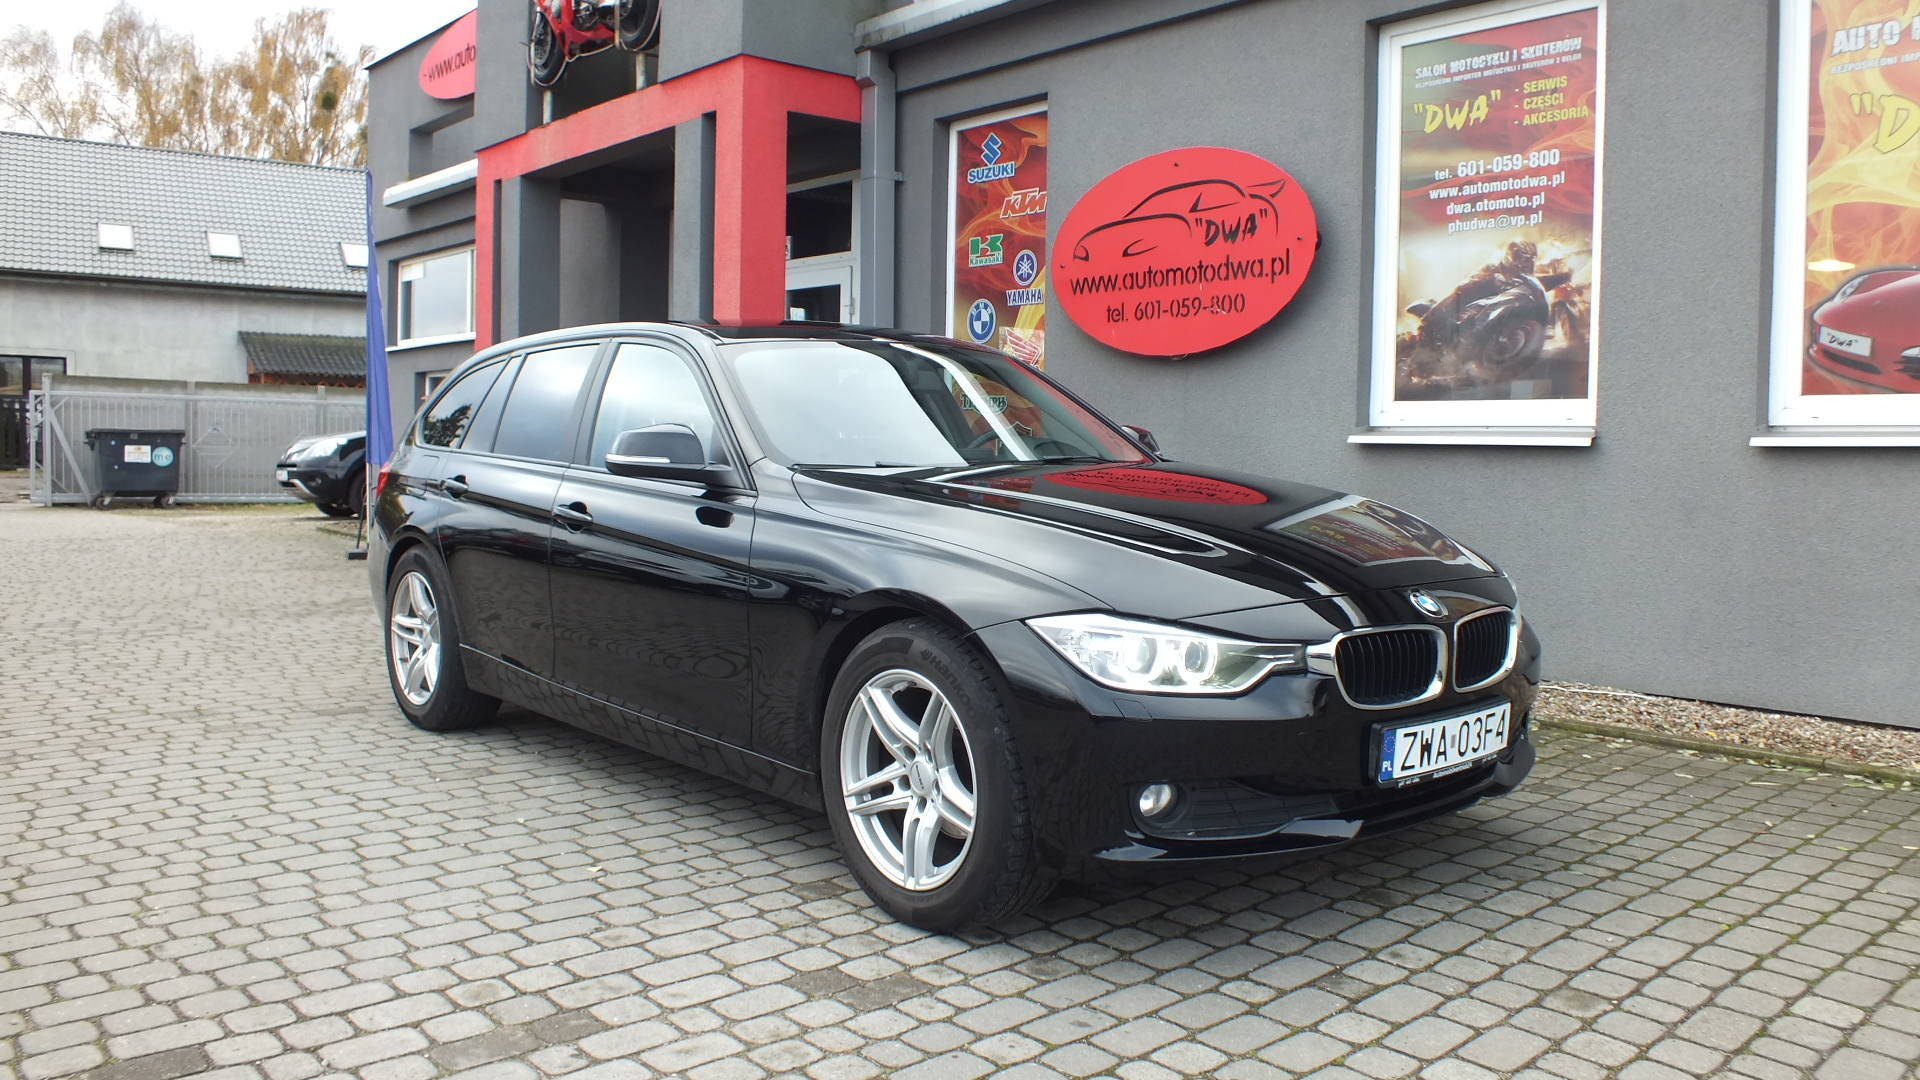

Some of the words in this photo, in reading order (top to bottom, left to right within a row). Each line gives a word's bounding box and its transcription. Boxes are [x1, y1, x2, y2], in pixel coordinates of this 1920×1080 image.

[1832, 20, 1901, 56] AUTO
[1416, 64, 1446, 79] SALON
[1450, 50, 1509, 73] MOTOCYKLI
[1521, 34, 1582, 59] SKUTERÓW
[1830, 56, 1898, 74] BEZPOŚREDNI
[1523, 76, 1568, 94] SERWIS
[1413, 90, 1502, 134] "DWA"
[1523, 92, 1564, 111] CZĘŚCI
[1523, 105, 1588, 126] AKCESORIA
[968, 162, 1015, 184] SUZUKI
[1434, 168, 1452, 181] tel.
[1457, 148, 1560, 177] 601-059-800
[1429, 170, 1565, 200] www.automotodwa.pl
[1447, 192, 1545, 215] dwa.otomoto.pl
[1196, 208, 1268, 246] "DWA"
[1448, 211, 1542, 234] phudwa@vp.pl
[969, 252, 1003, 267] Kawasaki
[1070, 247, 1291, 296] www.automotodwa.pl
[1006, 288, 1043, 306] YAMAHA
[1106, 303, 1129, 323] tel.
[1134, 293, 1246, 322] 601-059-800
[1400, 725, 1448, 772] ZWA
[1457, 708, 1507, 758] 03F4
[1382, 760, 1392, 772] PL
